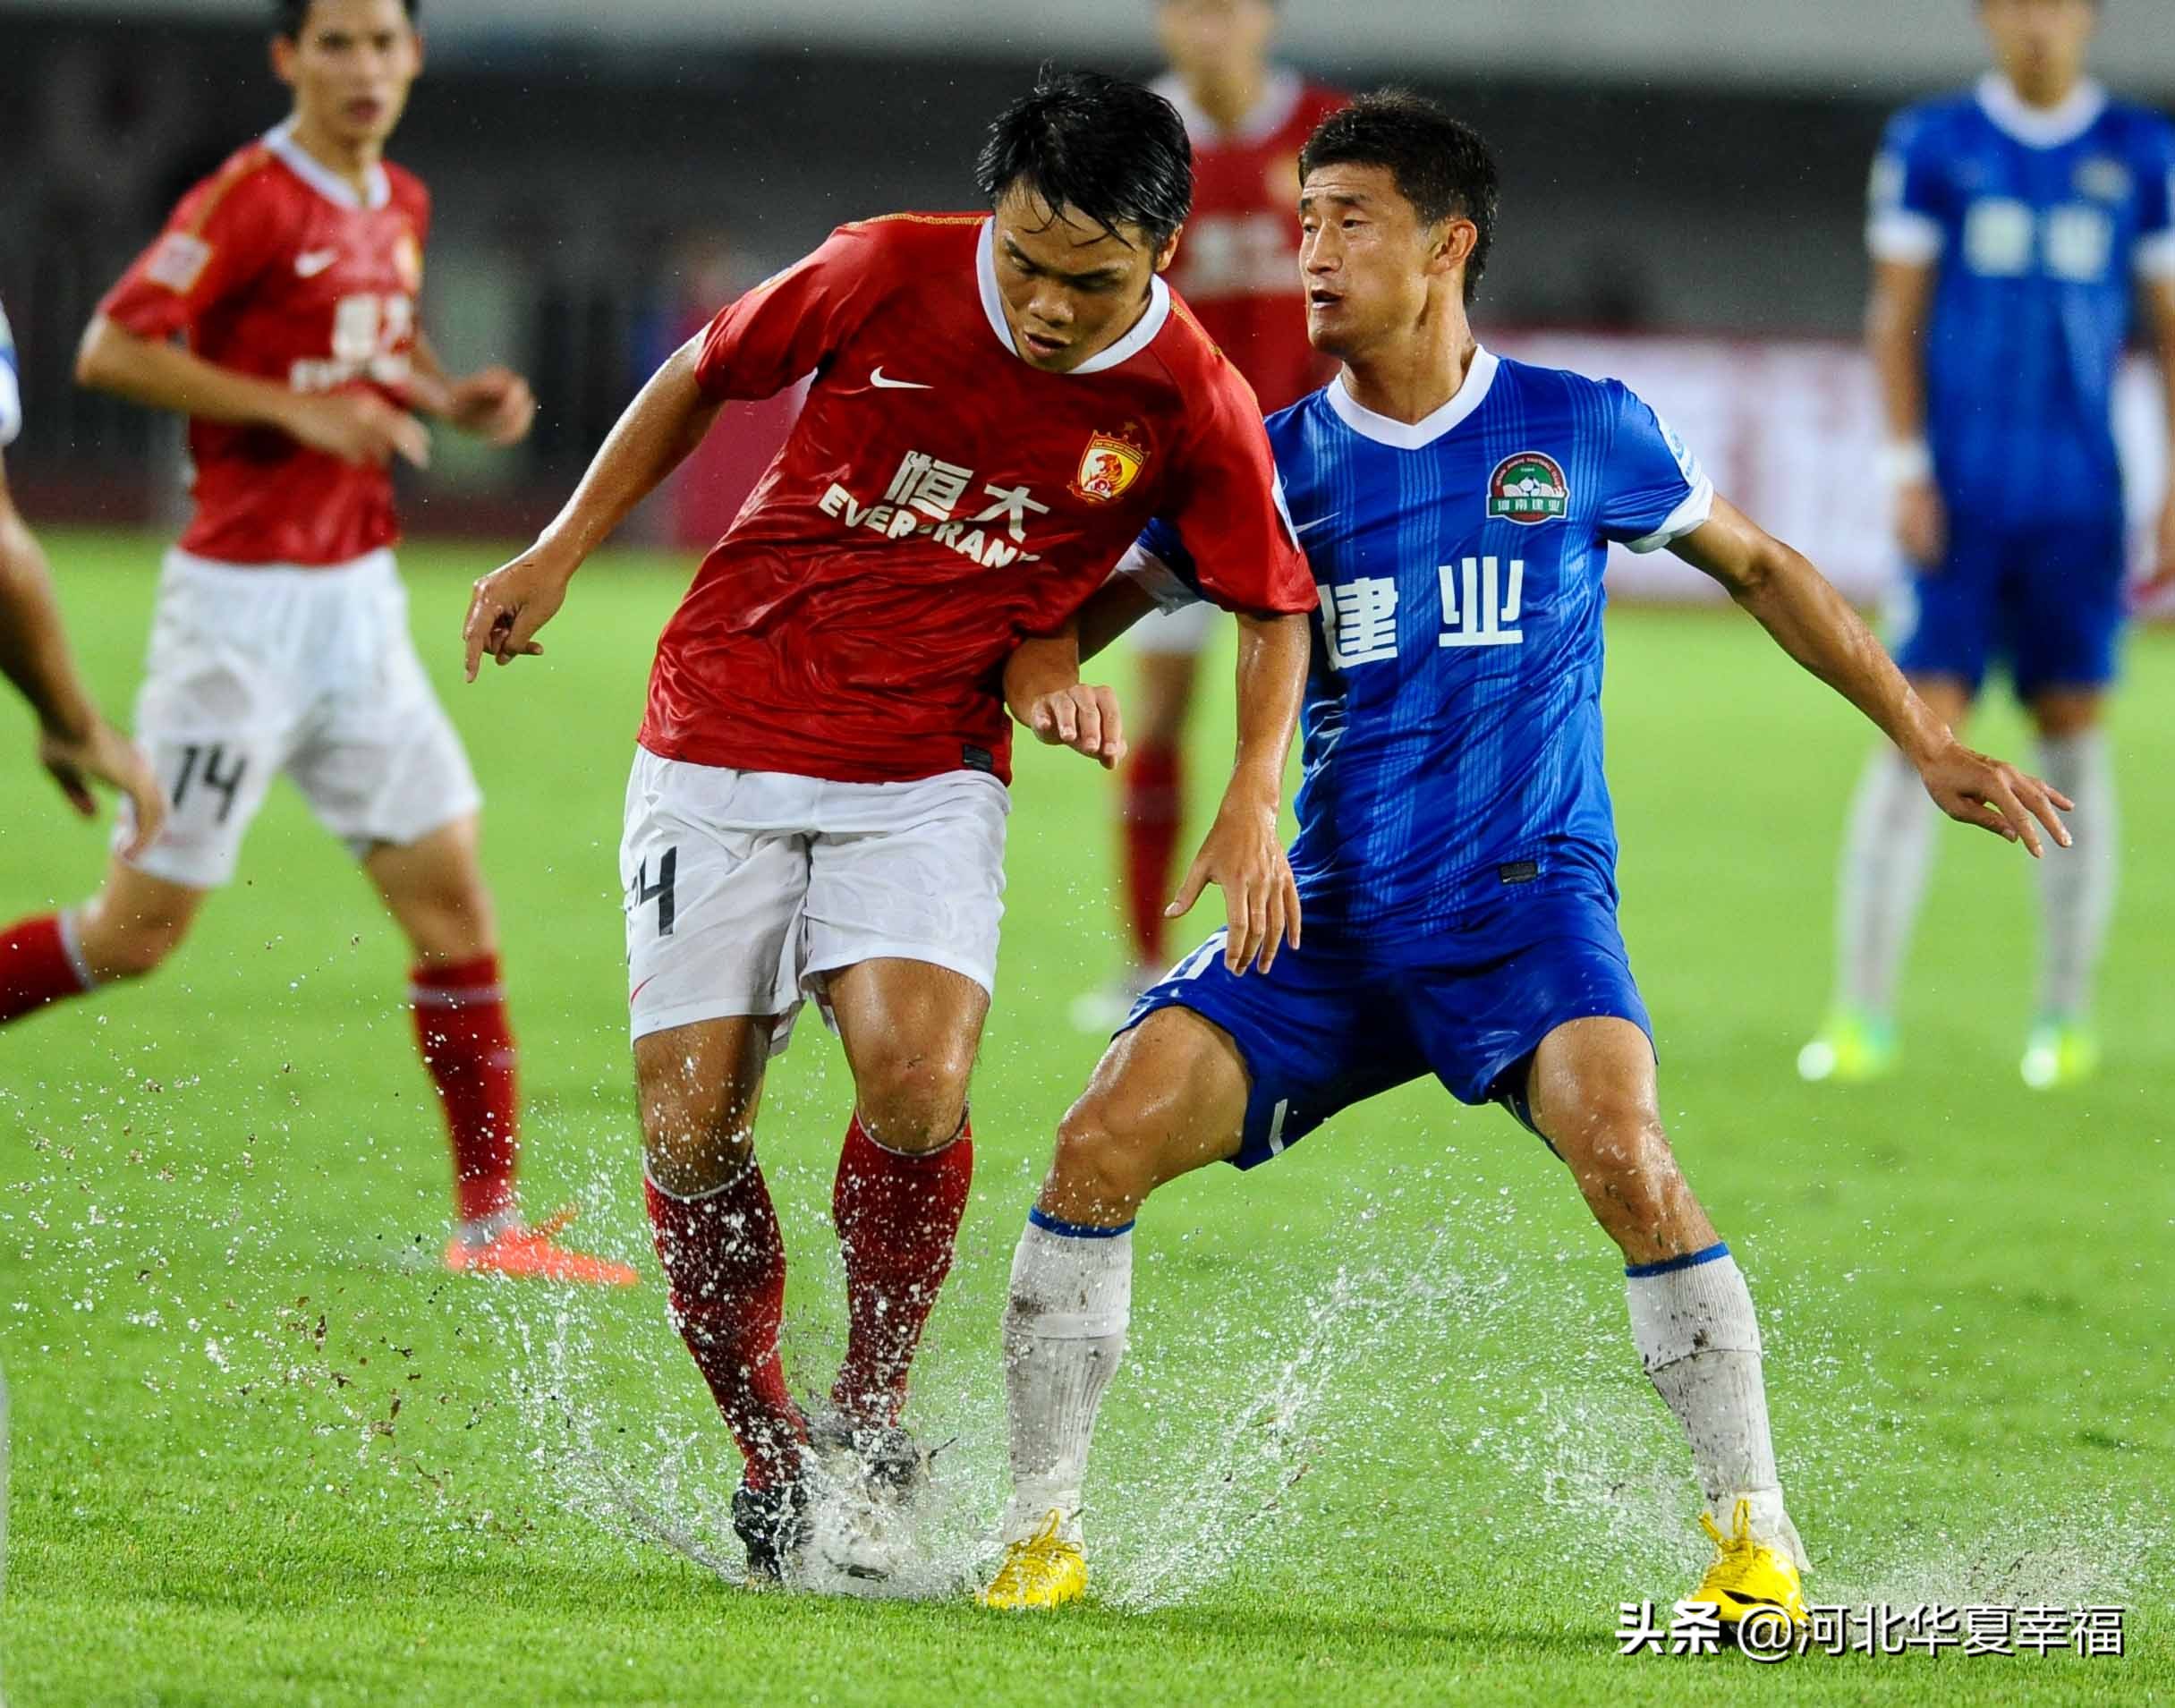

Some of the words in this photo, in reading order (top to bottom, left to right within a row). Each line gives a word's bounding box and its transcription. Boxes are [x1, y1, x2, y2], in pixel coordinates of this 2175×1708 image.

[818, 482, 1041, 569] EVERRAN
[884, 450, 1050, 543] 恒大
[1318, 556, 1525, 671] 建业
[173, 743, 248, 824] 14
[624, 846, 677, 938] 4
